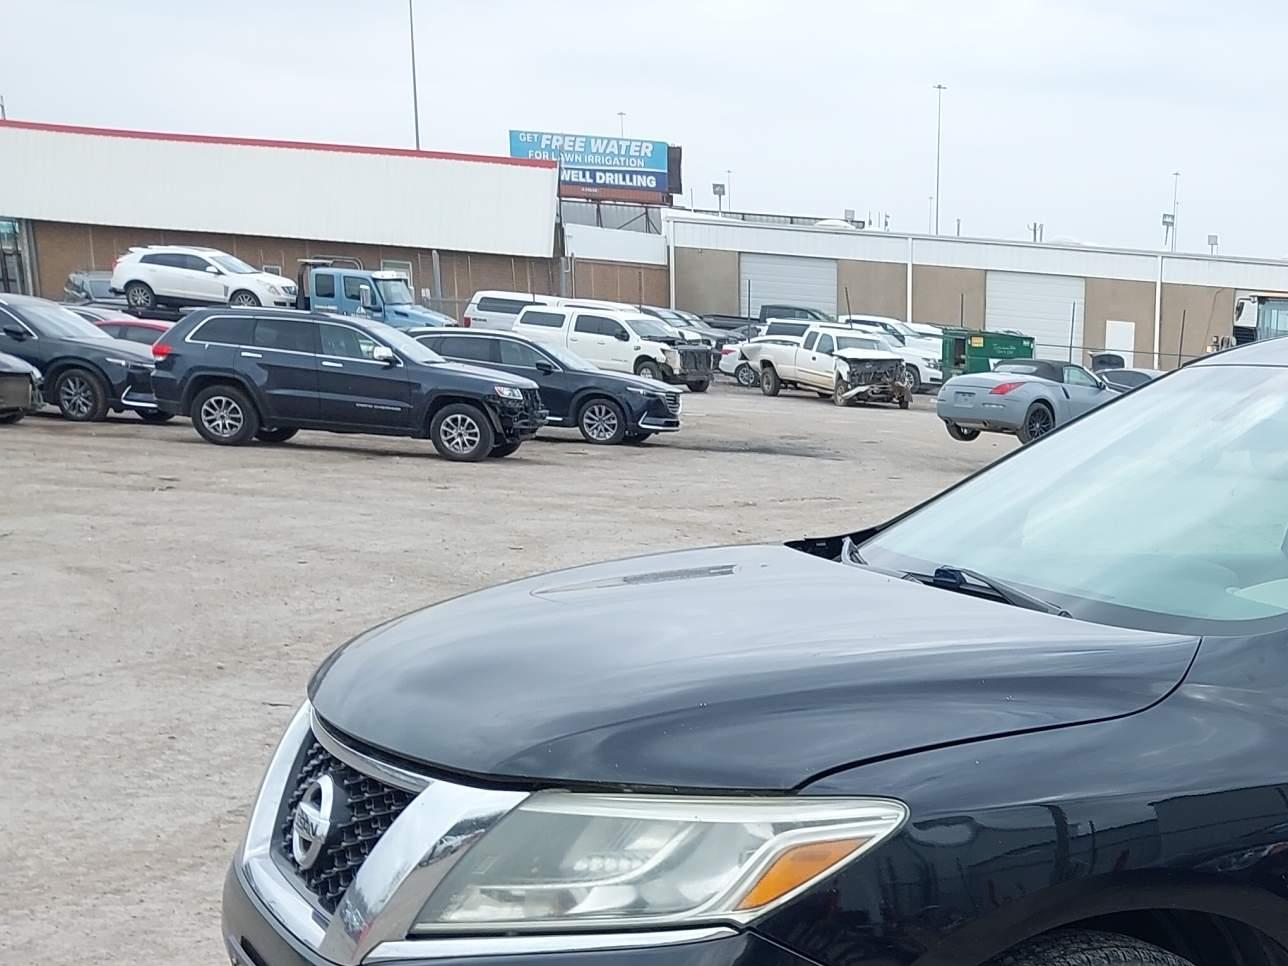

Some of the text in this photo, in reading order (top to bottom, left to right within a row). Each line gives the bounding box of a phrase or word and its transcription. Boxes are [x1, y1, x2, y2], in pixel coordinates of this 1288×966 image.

[519, 132, 653, 157] GET FREE WATER
[528, 149, 645, 168] FOR LAWN IRRIGATION
[560, 169, 657, 187] WELL DRILLING
